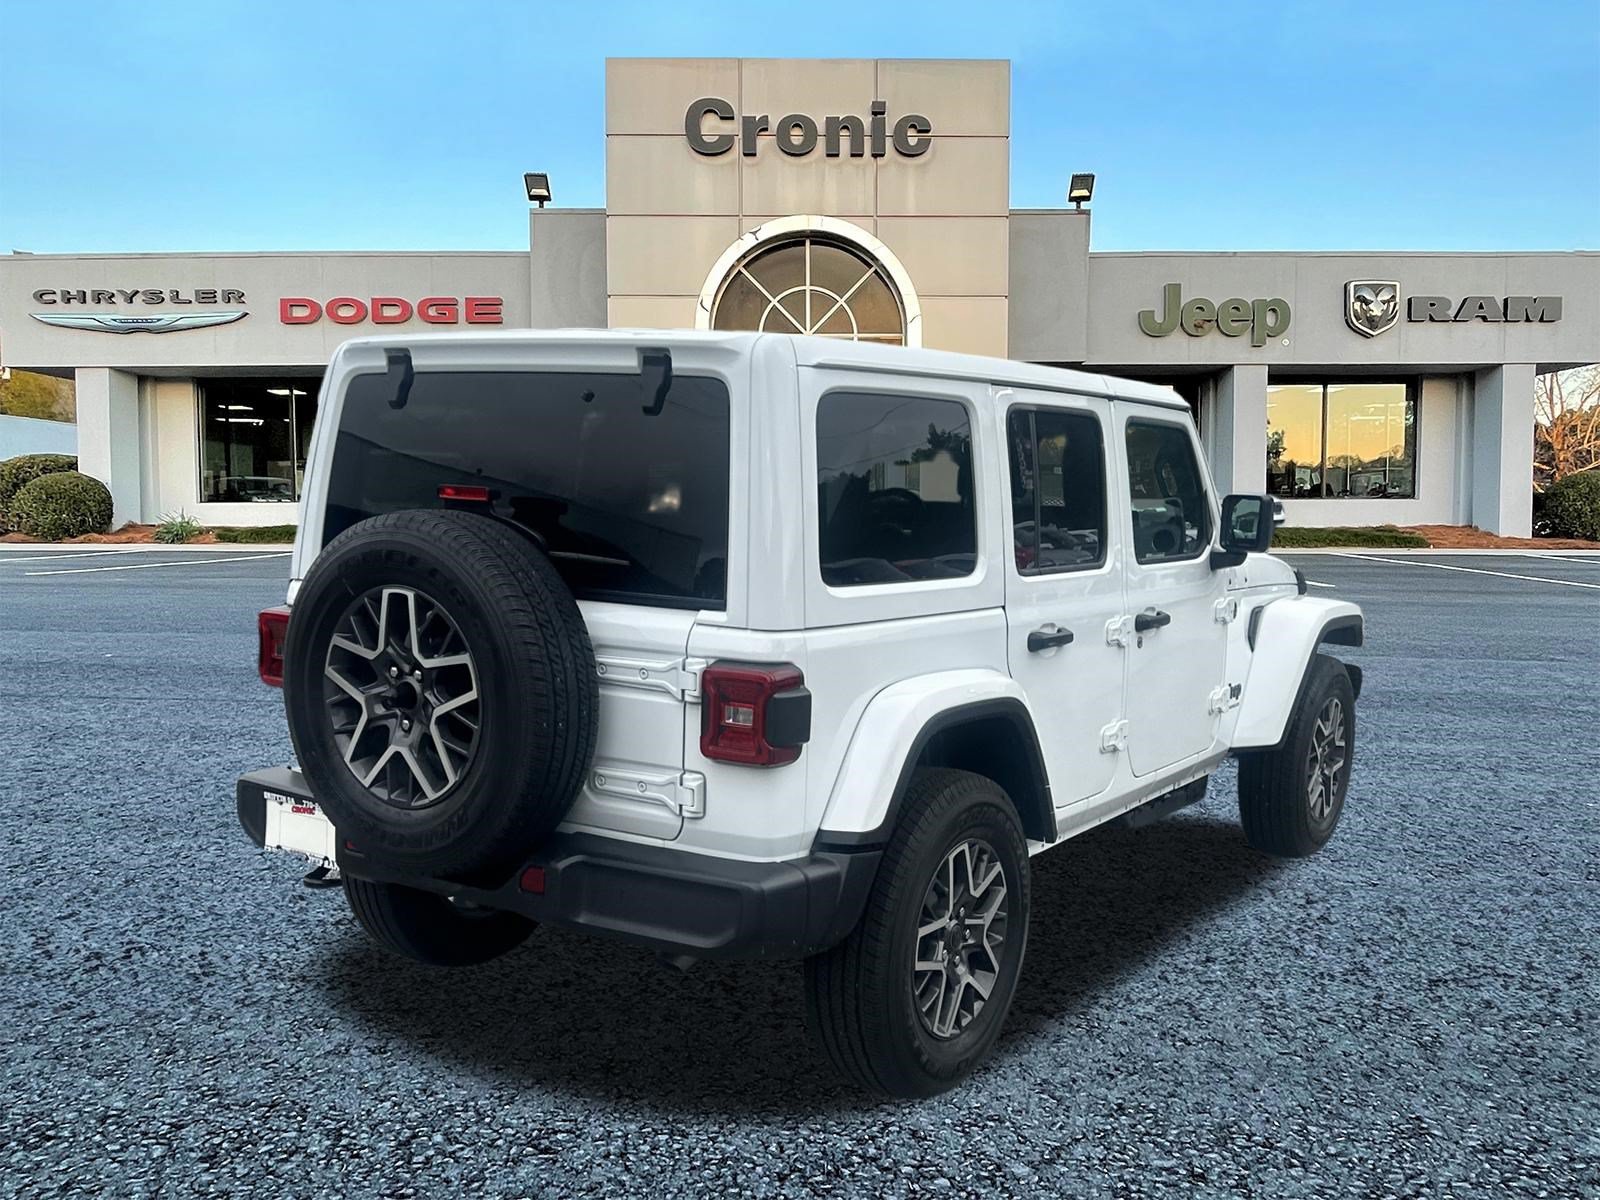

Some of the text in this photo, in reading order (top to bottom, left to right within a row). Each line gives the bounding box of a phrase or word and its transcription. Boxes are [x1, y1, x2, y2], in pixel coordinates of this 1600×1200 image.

[685, 97, 932, 158] Cronic
[33, 288, 247, 305] CHRYSLER
[280, 296, 504, 325] DODGE
[1408, 295, 1563, 323] RAM
[1138, 283, 1291, 347] Jeep
